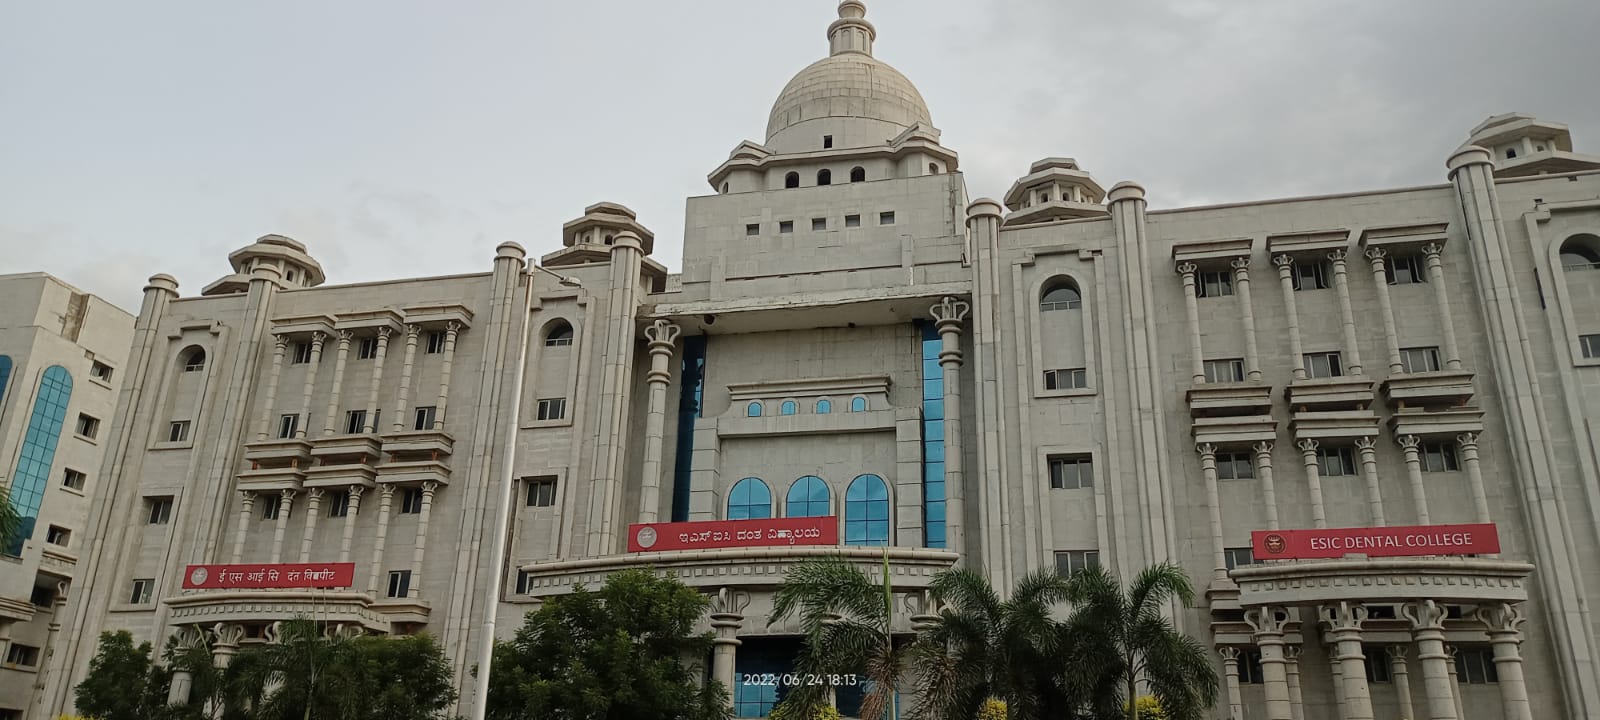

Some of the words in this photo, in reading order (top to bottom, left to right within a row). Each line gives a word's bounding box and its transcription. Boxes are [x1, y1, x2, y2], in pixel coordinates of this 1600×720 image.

[736, 529, 762, 540] ದಂತ
[1310, 536, 1341, 550] ESIC
[1345, 535, 1402, 549] DENTAL
[1406, 533, 1473, 547] COLLEGE
[219, 568, 226, 583] ई
[229, 572, 243, 585] एस
[247, 568, 266, 583] आई
[268, 569, 280, 582] सि
[287, 569, 300, 582] दंत
